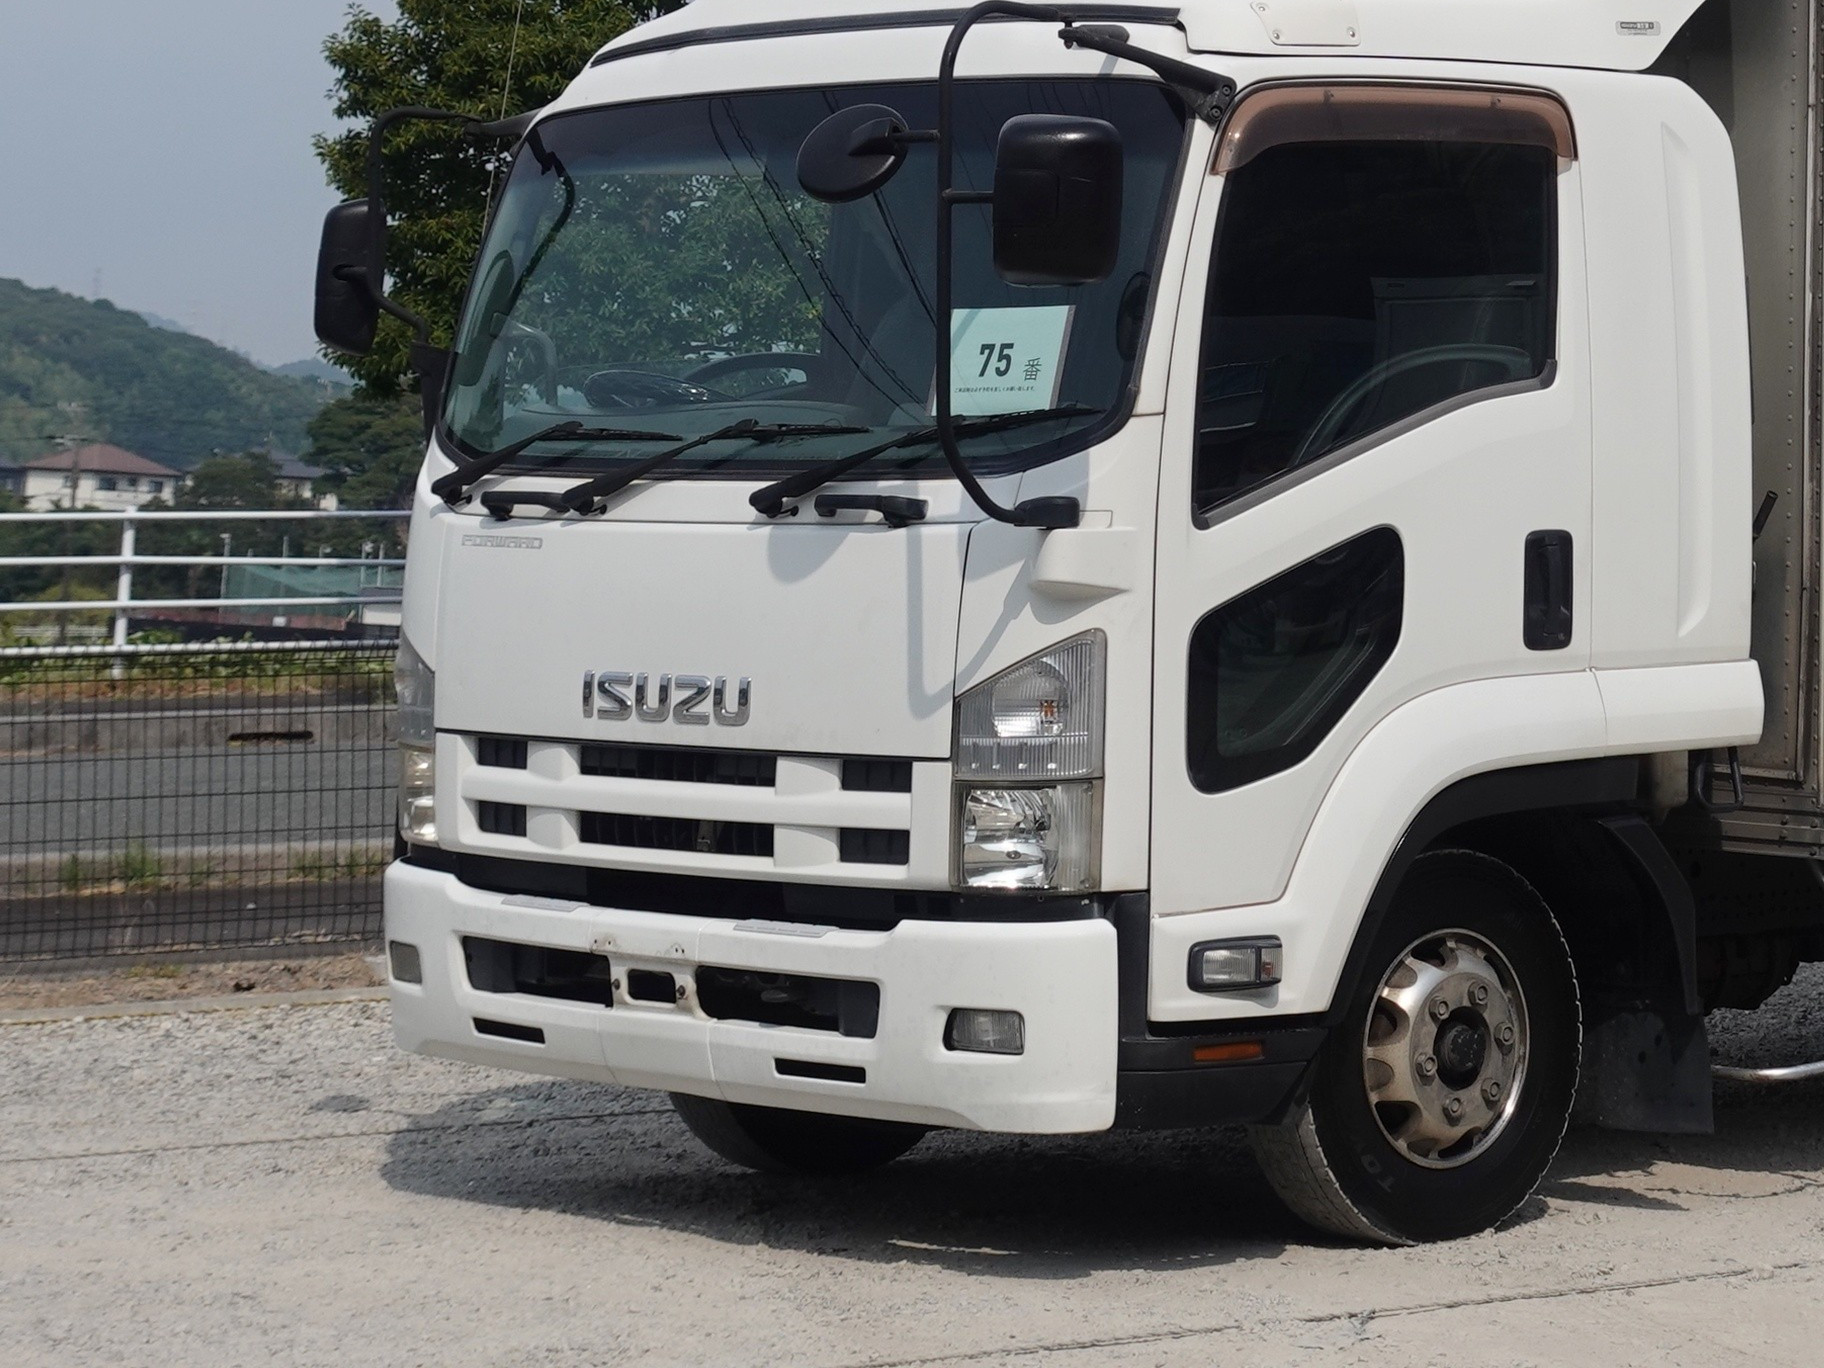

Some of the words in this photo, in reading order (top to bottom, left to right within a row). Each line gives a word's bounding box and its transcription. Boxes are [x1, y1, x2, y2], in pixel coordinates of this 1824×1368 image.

[978, 342, 1015, 378] 75
[1022, 357, 1043, 382] 番
[582, 669, 753, 727] ISUZU
